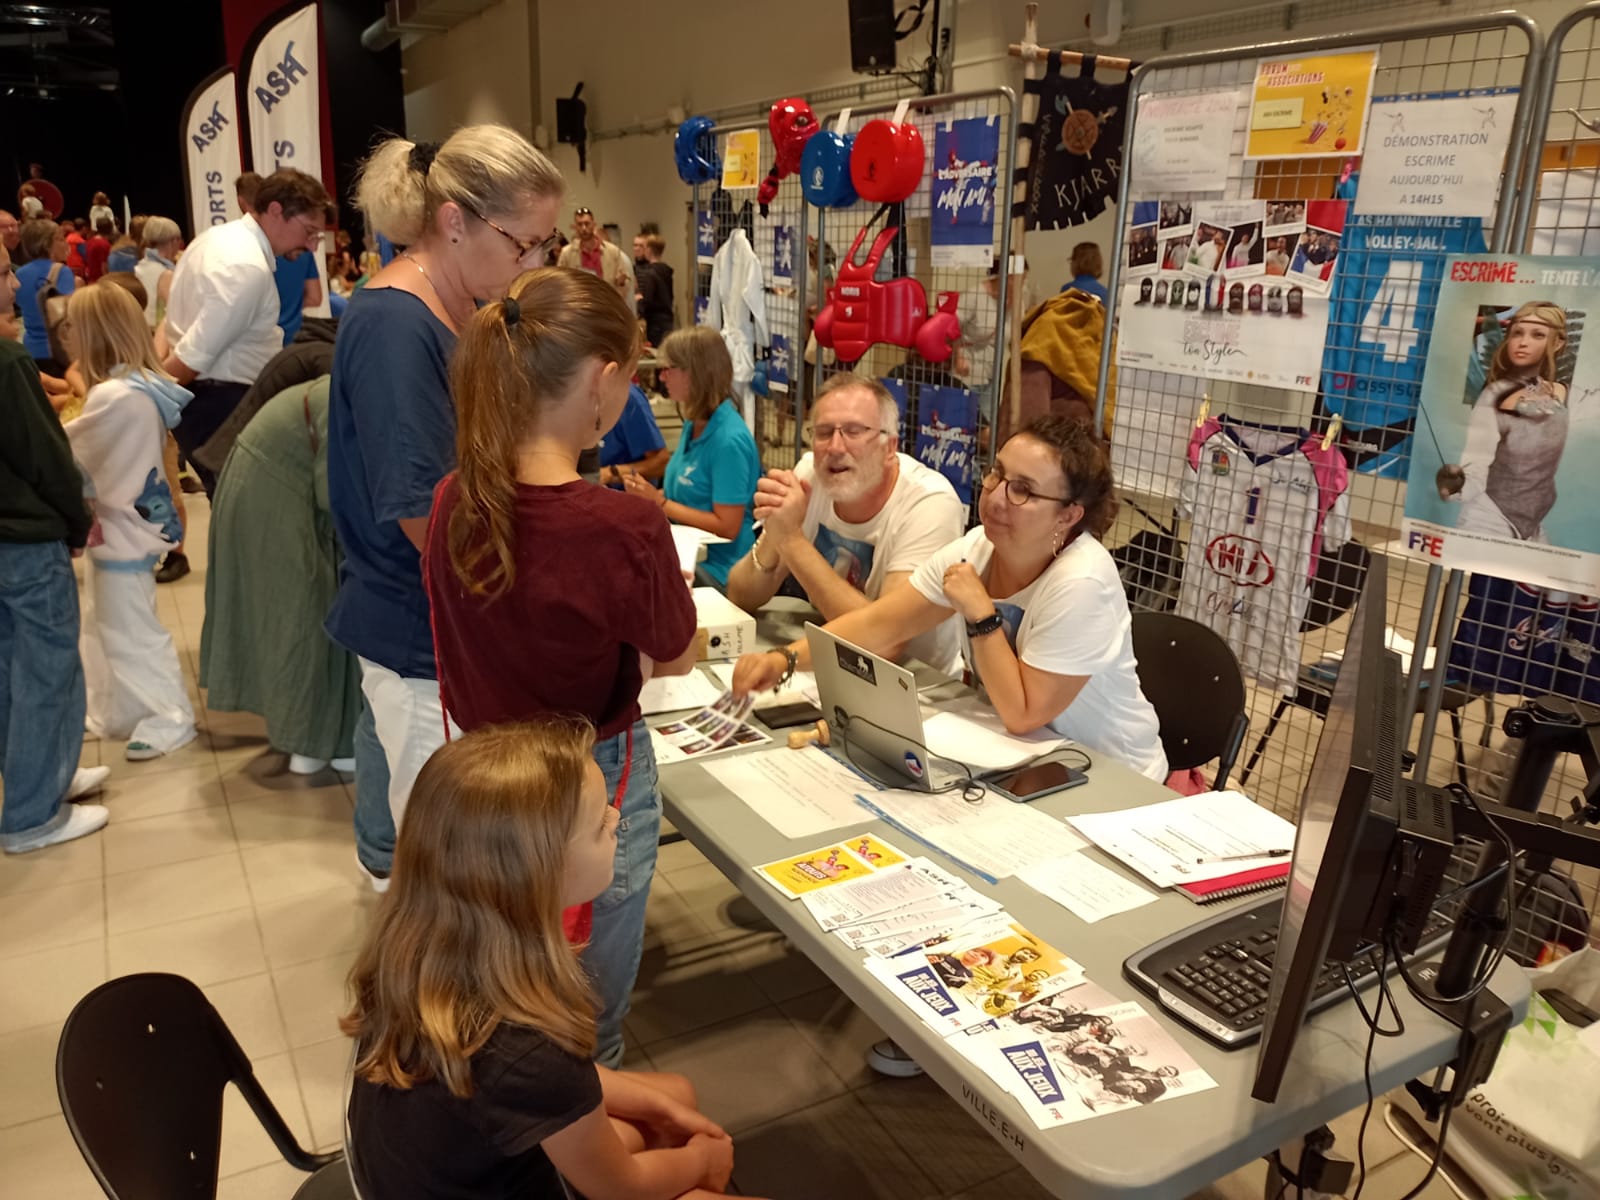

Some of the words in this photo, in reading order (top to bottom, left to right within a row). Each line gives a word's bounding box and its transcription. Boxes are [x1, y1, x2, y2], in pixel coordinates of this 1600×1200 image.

[1404, 154, 1456, 167] ESCRIME
[1389, 174, 1463, 185] AUJOURD'HUI
[1410, 194, 1444, 205] 14H15
[1541, 269, 1578, 286] TENTE
[1360, 260, 1421, 363] 4
[1246, 486, 1262, 525] 1
[1408, 530, 1444, 558] FFE
[902, 974, 930, 993] AUX
[919, 989, 952, 1013] JEUX
[1007, 1051, 1037, 1072] AUX
[1023, 1071, 1059, 1098] JEUX
[1506, 1134, 1547, 1161] plus
